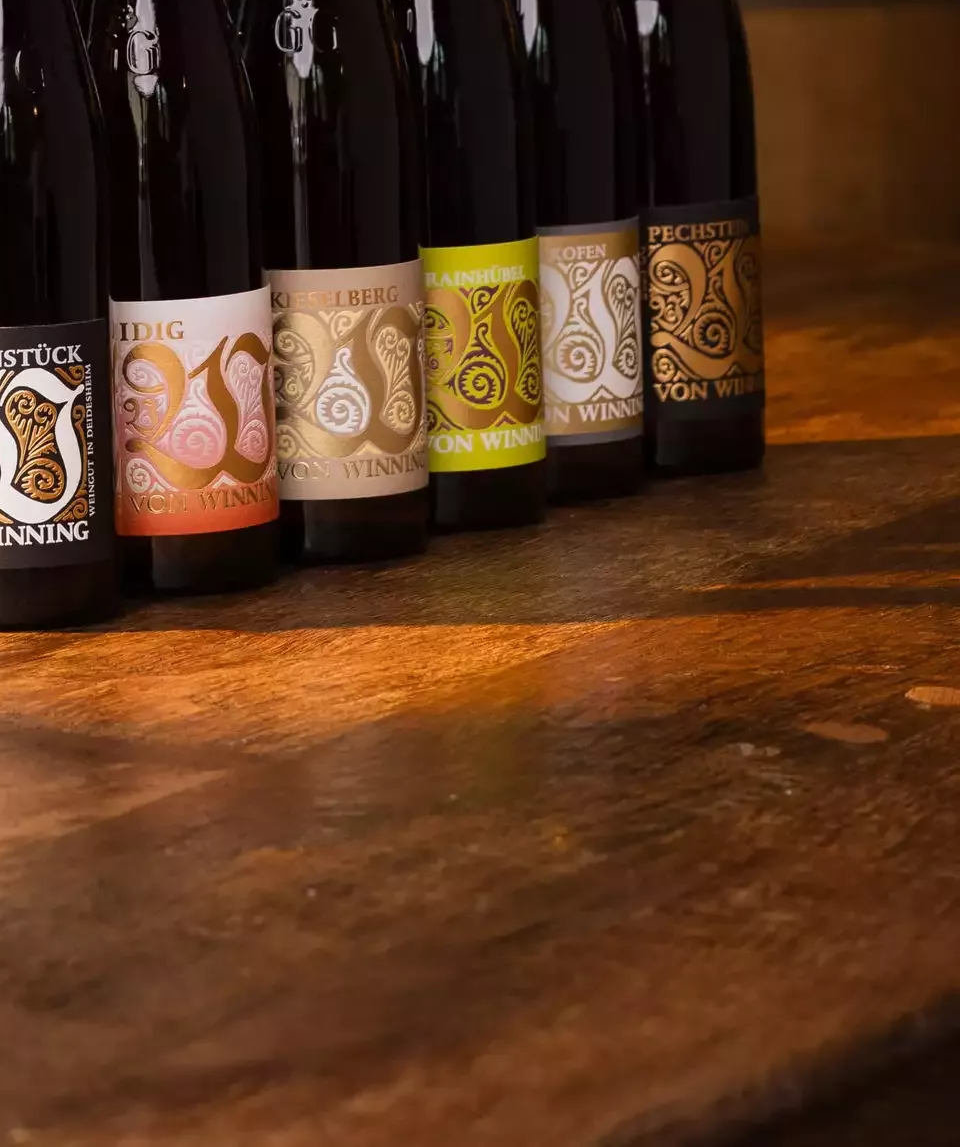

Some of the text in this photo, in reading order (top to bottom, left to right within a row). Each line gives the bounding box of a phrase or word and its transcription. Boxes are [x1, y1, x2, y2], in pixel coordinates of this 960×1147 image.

[271, 286, 398, 309] KIESELBERG
[119, 320, 185, 341] IDIG
[85, 364, 94, 438] DEIDESHEIM
[653, 382, 708, 402] VON
[87, 441, 94, 455] IN
[276, 460, 331, 481] VON
[129, 493, 188, 515] VON
